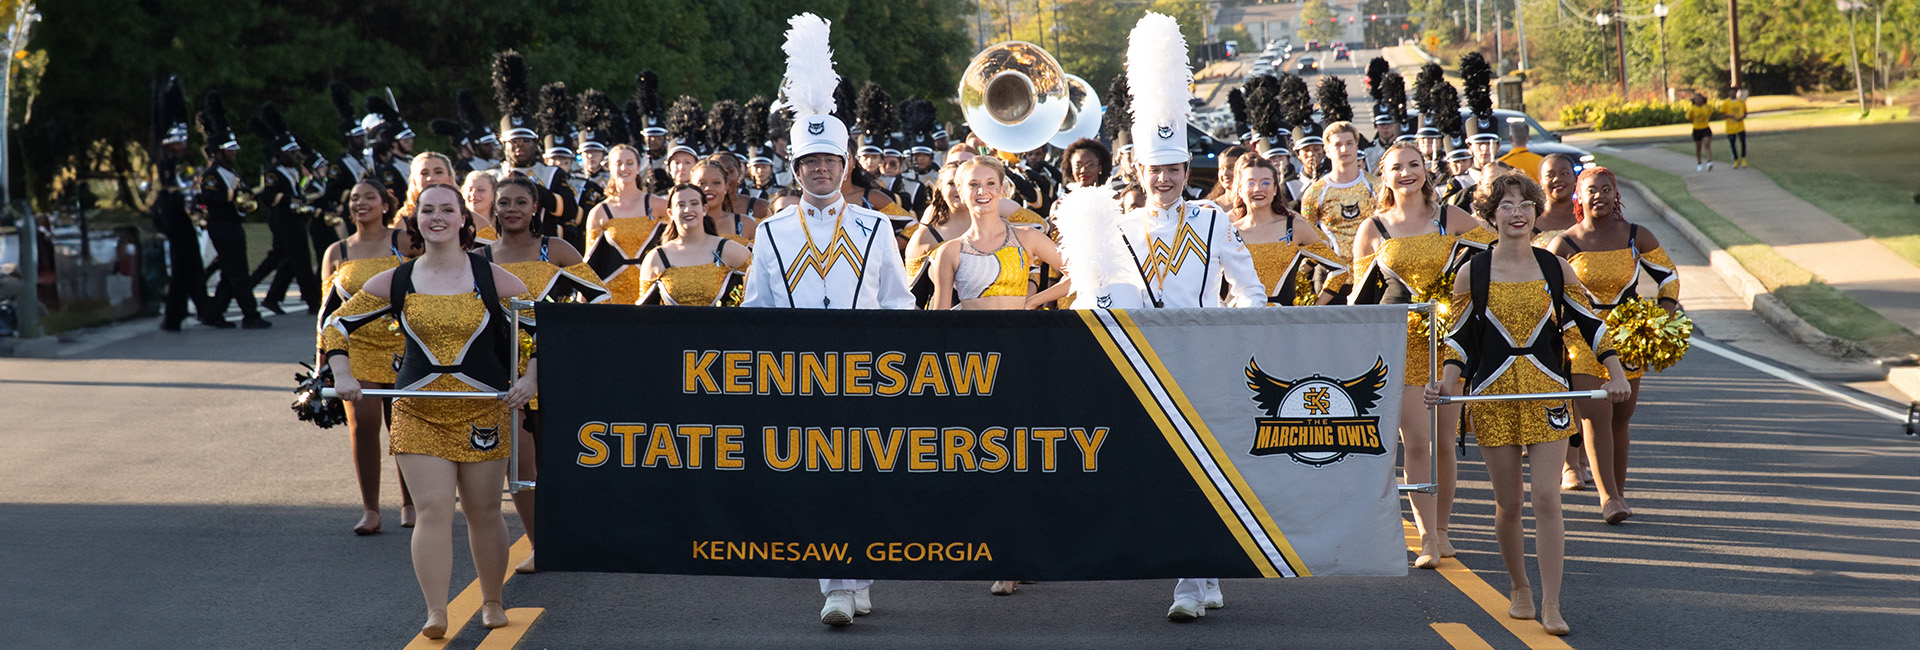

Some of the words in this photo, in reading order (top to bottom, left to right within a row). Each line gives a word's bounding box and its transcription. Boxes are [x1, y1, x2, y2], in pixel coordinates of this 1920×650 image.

[683, 350, 1001, 397] KENNESAW
[576, 421, 745, 471] STATE
[762, 425, 1110, 473] UNIVERSITY
[1256, 425, 1334, 449] MARCHING
[1337, 425, 1379, 448] OWLS
[692, 541, 853, 564] KENNESAW,
[866, 542, 993, 562] GEORGIA
